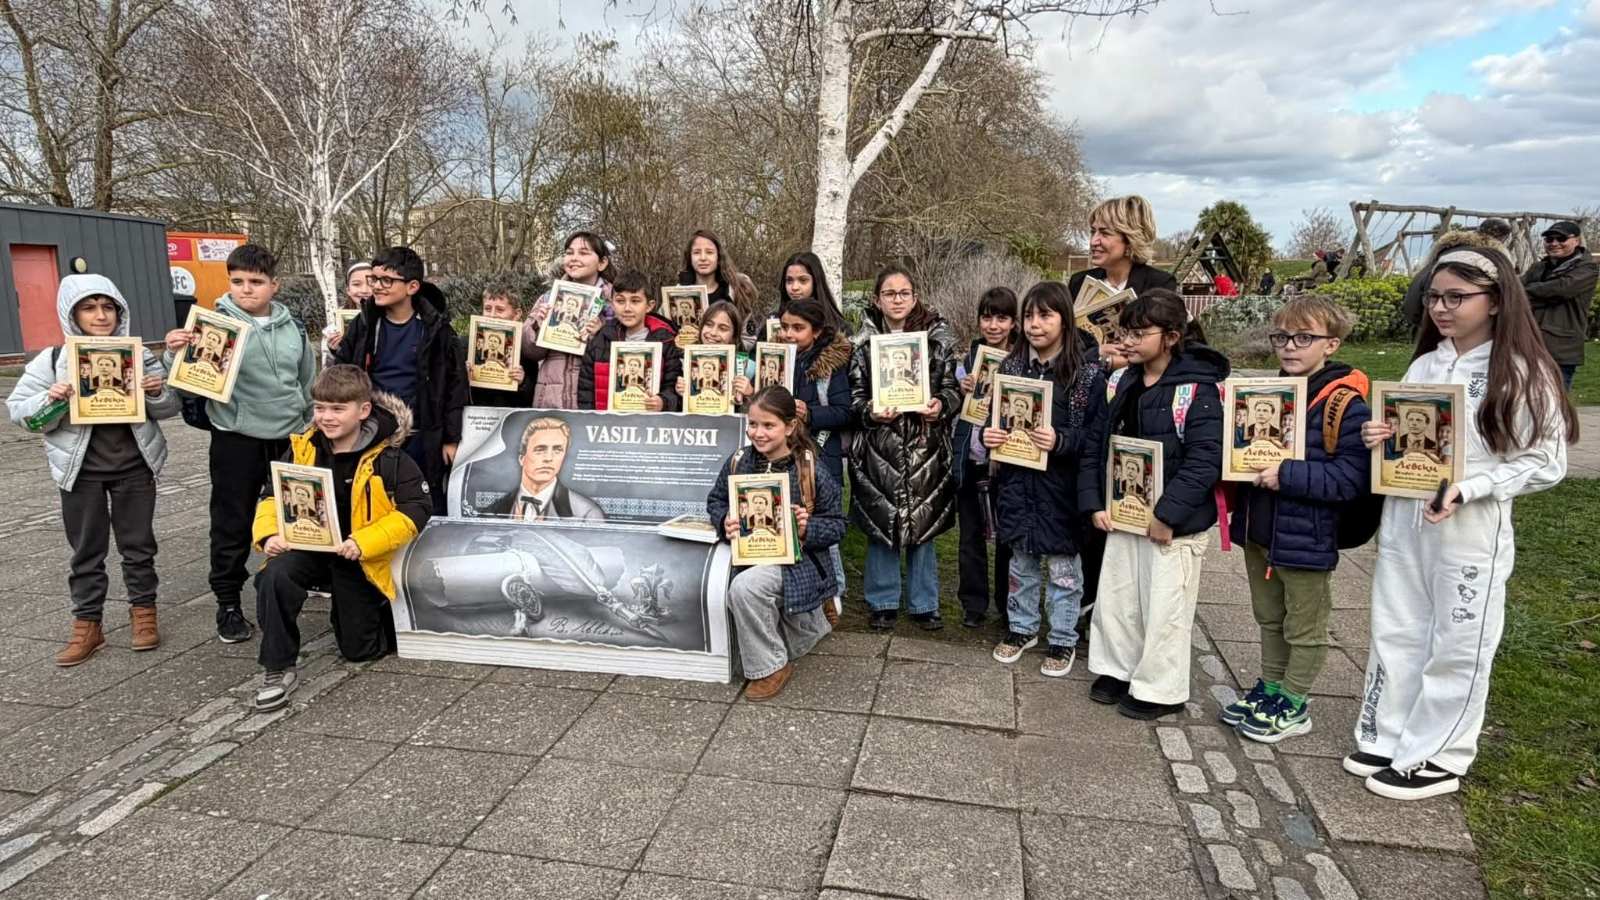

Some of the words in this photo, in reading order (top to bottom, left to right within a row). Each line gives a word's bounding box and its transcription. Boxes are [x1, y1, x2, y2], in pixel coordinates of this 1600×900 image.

[586, 425, 642, 444] VASIL
[646, 427, 719, 447] LEVSKI
[1395, 460, 1438, 472] Левски
